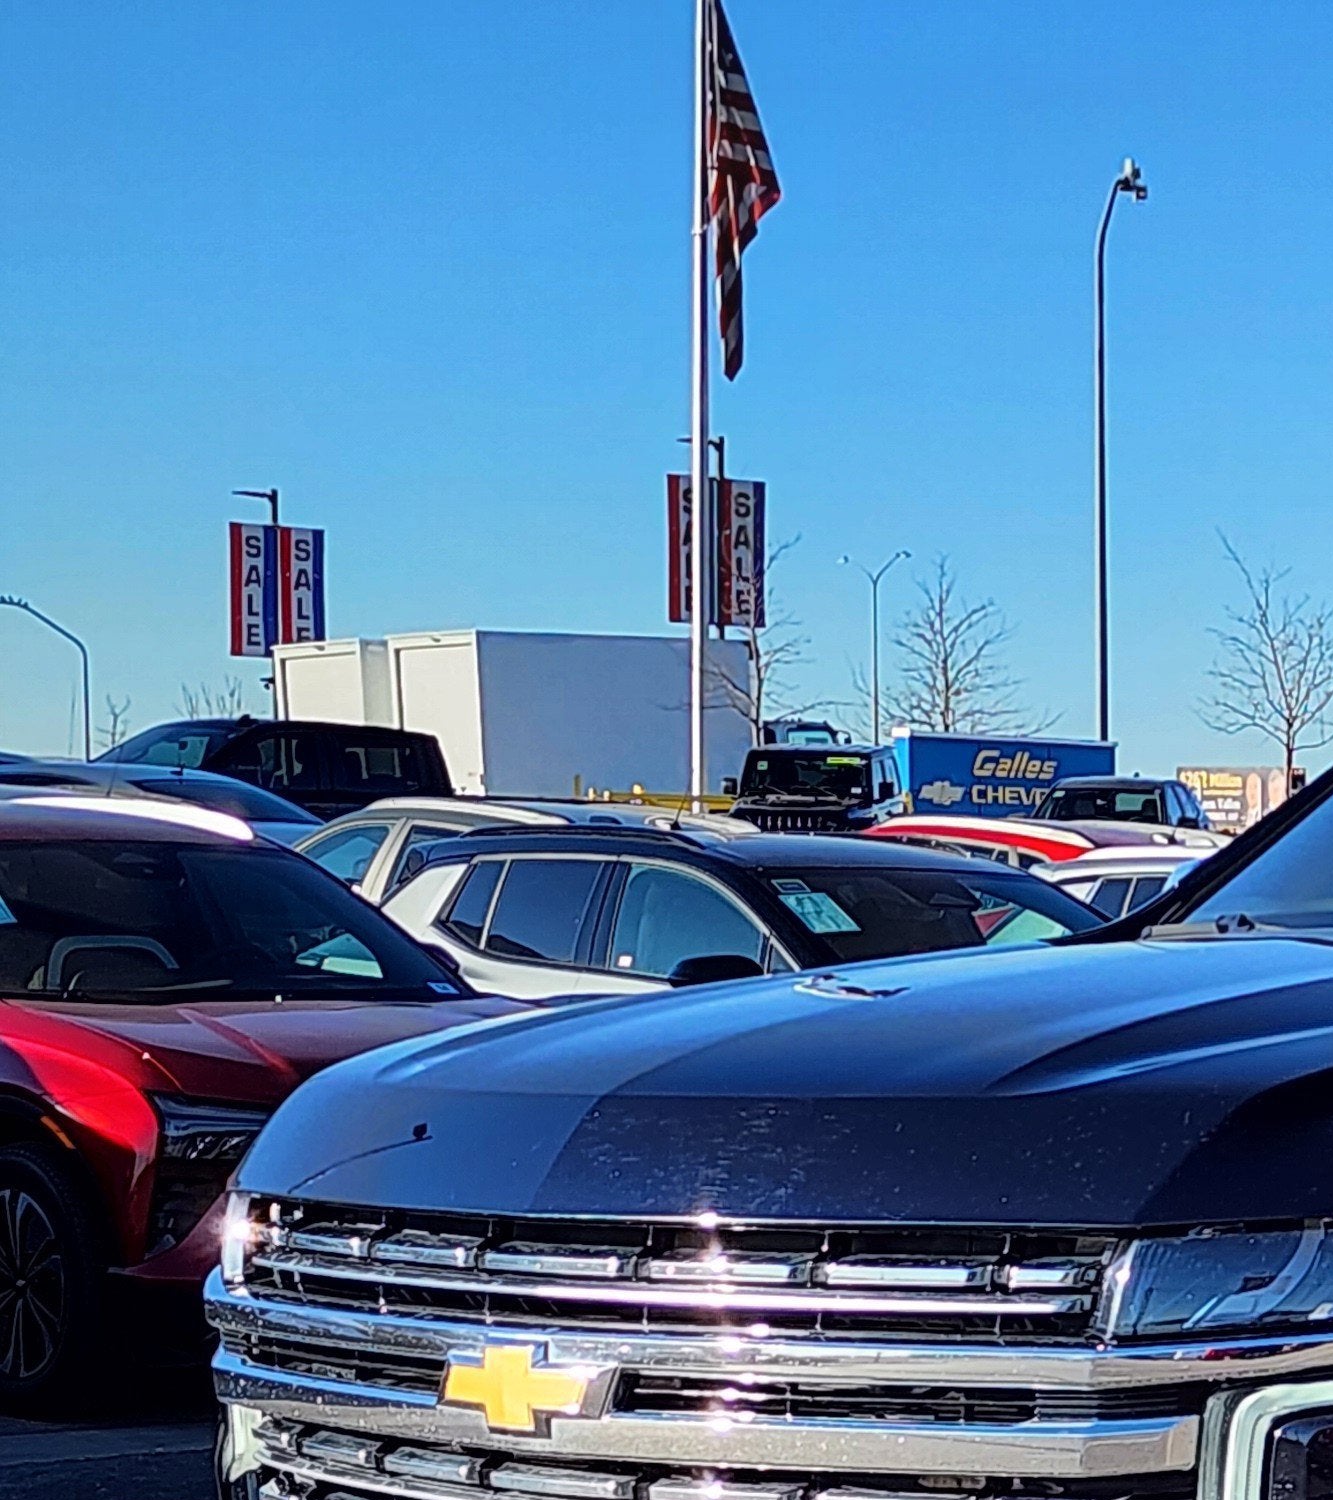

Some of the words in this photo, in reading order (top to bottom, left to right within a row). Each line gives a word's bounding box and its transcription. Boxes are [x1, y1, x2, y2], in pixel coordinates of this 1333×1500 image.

[244, 535, 261, 646] SALE
[734, 492, 752, 616] SALE
[973, 749, 1058, 780] Galles
